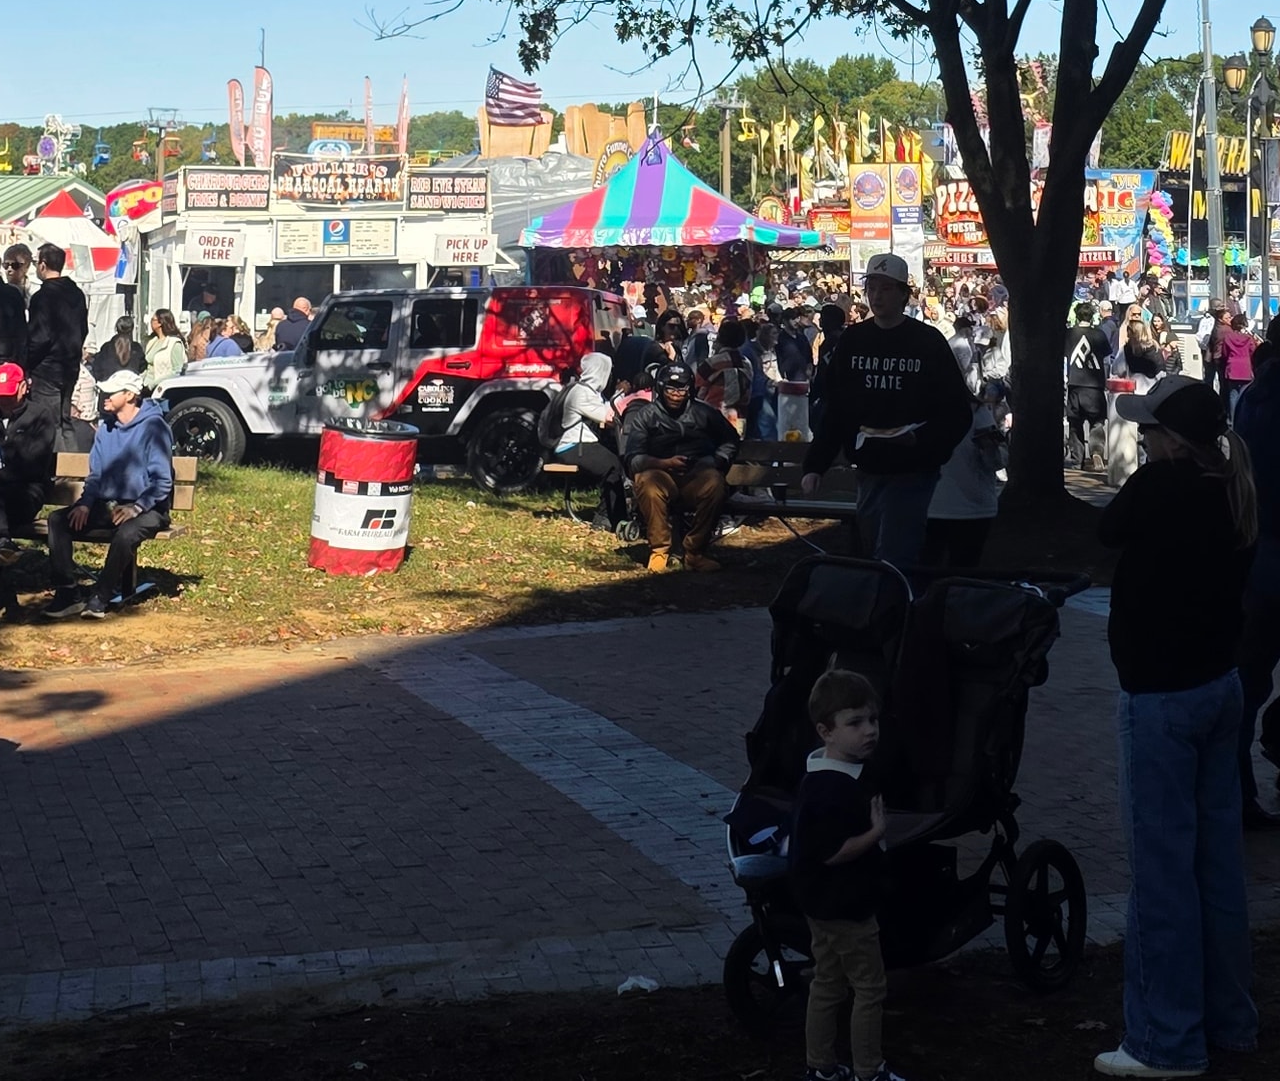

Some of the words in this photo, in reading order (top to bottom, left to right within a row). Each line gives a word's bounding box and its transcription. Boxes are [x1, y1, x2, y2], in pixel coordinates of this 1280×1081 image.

[290, 162, 388, 177] FULLER'S
[593, 154, 607, 188] hurro
[186, 174, 269, 191] CHARBURGERS
[411, 177, 431, 192] RIB
[432, 177, 452, 192] EYE
[455, 178, 486, 193] STEAK
[188, 193, 218, 207] FRIES
[220, 194, 228, 207] &
[410, 195, 485, 208] SANDWICHES
[935, 181, 982, 217] PIZZ
[947, 222, 977, 233] FRESH
[199, 236, 235, 248] ORDER
[964, 231, 983, 243] HOT
[446, 239, 470, 250] PICK
[474, 239, 488, 250] UP
[203, 249, 231, 260] HERE
[453, 252, 479, 263] HERE
[851, 356, 879, 370] FEAR
[883, 357, 897, 370] OF
[899, 358, 921, 373] GOD
[316, 383, 332, 397] got
[333, 380, 346, 392] to
[865, 375, 902, 390] STATE
[333, 389, 346, 399] be
[347, 379, 375, 405] NC
[338, 529, 360, 537] FARM
[362, 530, 393, 539] BUREAU
